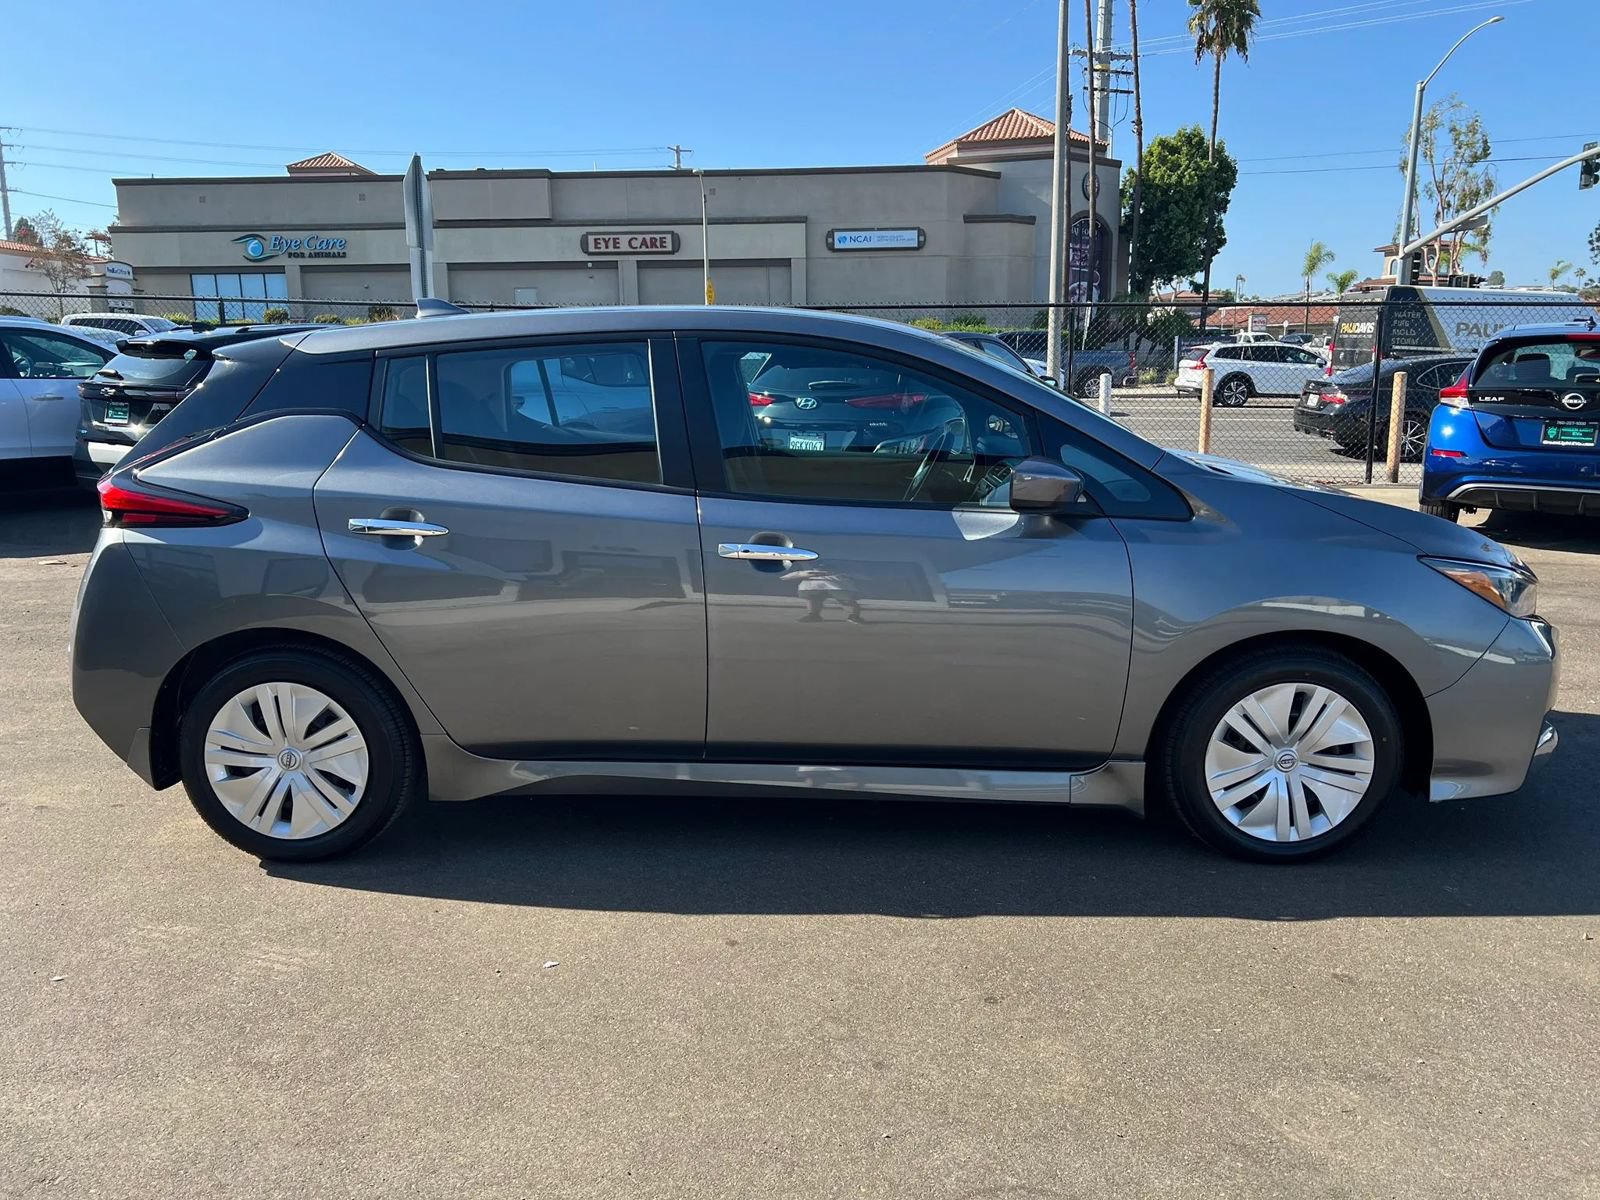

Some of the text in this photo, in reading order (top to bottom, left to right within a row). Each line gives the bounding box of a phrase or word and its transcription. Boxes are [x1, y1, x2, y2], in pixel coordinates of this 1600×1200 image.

[270, 234, 347, 256] Eye Care
[593, 236, 667, 250] EYE CARE
[849, 235, 872, 244] NCAI
